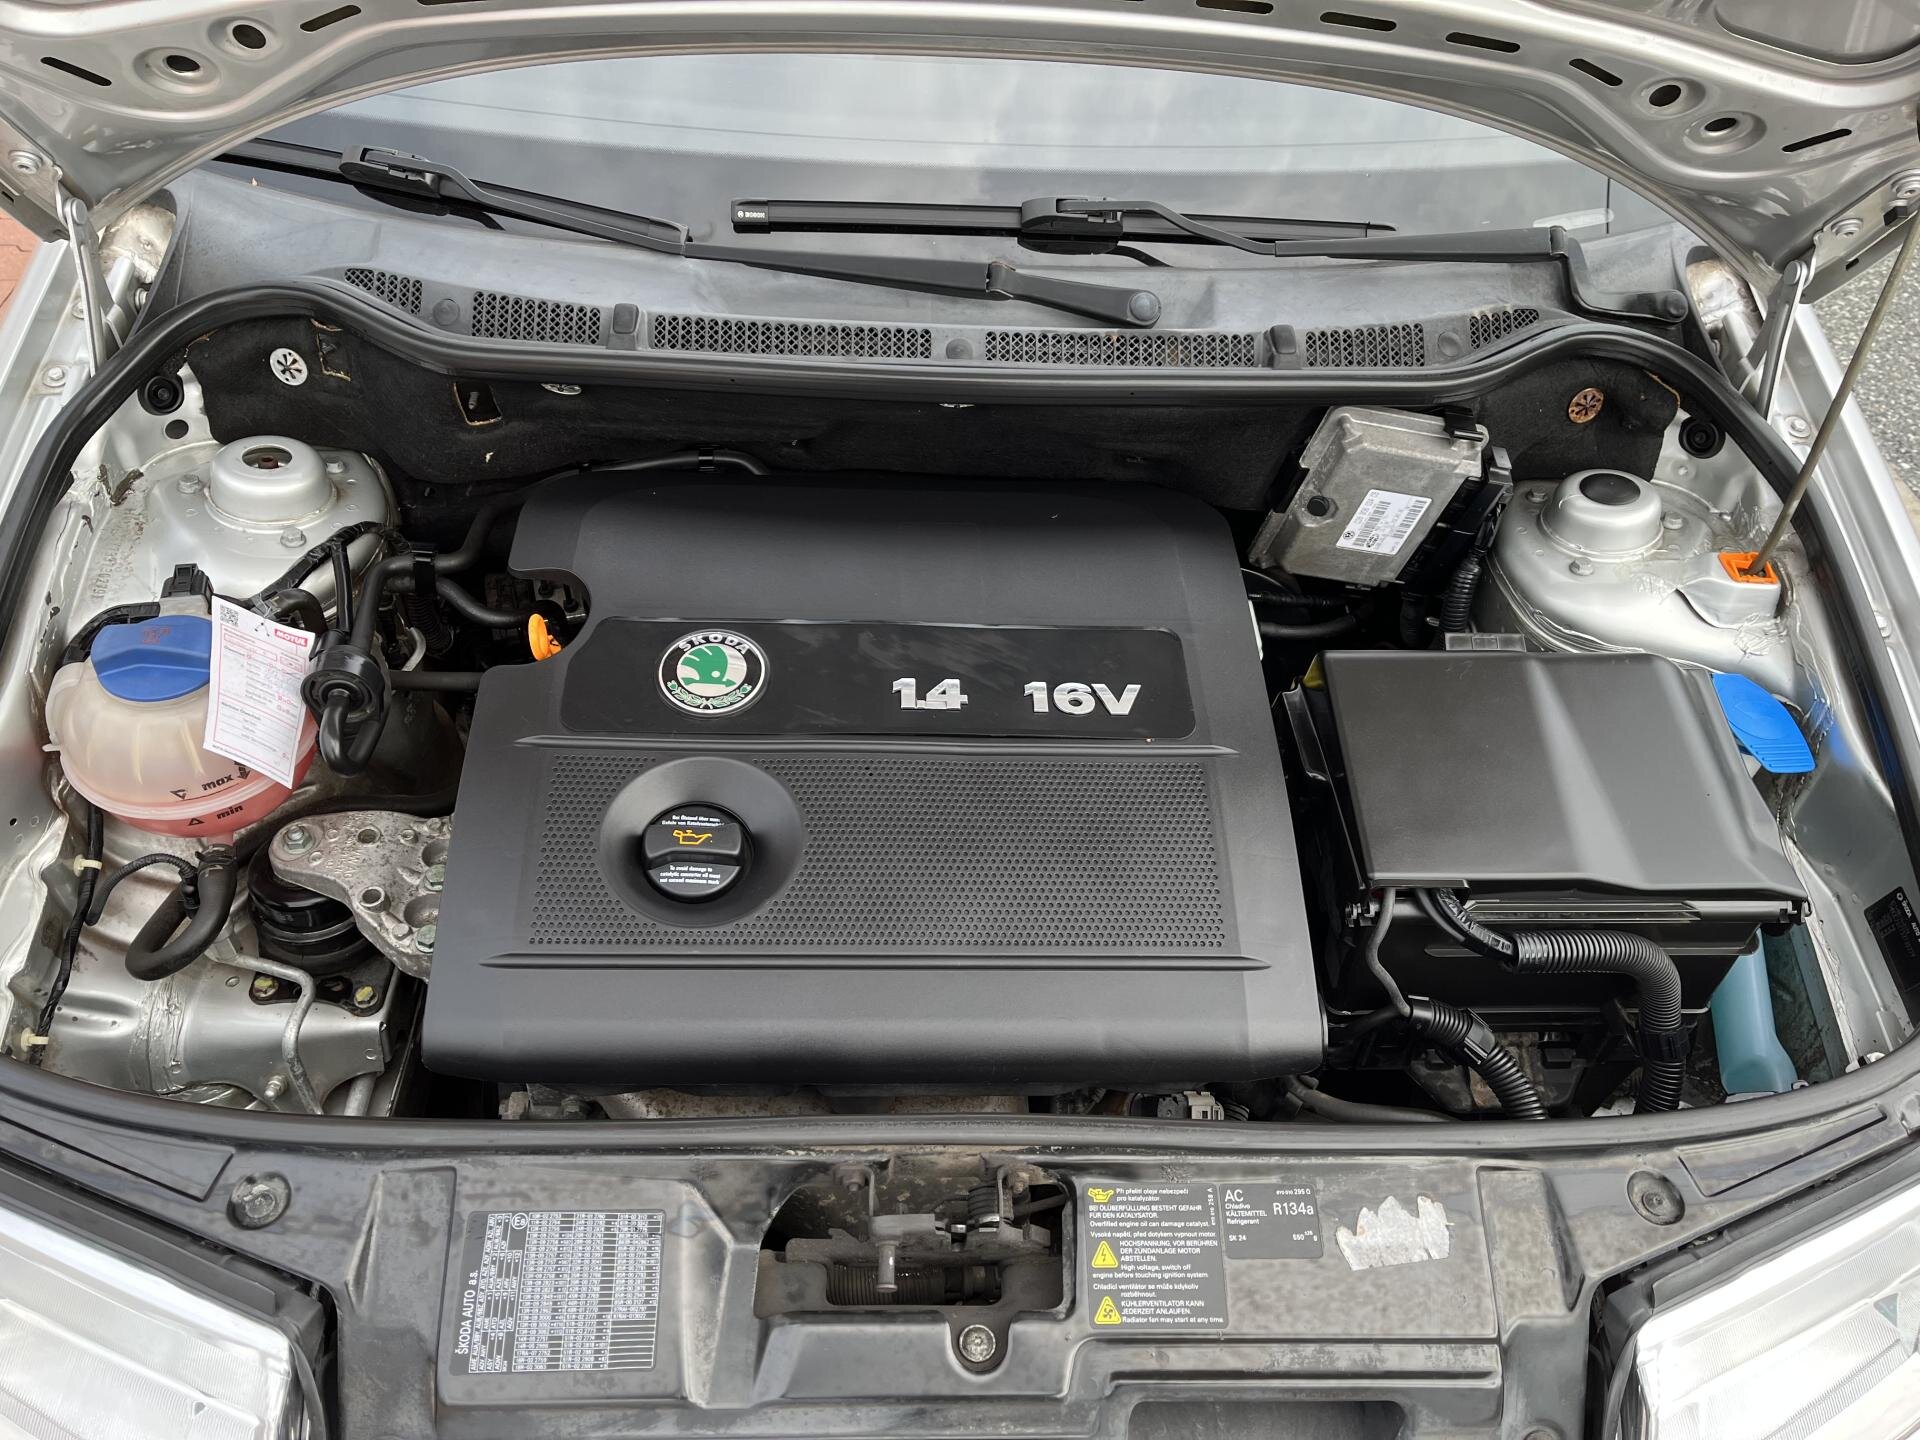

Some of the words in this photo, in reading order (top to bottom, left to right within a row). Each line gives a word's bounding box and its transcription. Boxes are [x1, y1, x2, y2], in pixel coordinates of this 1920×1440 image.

[276, 630, 308, 647] MOTUL
[892, 677, 969, 710] 1.4
[1024, 681, 1142, 716] 16V
[201, 774, 234, 791] max
[216, 805, 243, 819] min
[1224, 1189, 1244, 1202] AC
[1272, 1202, 1314, 1216] R134a
[1183, 1263, 1191, 1271] off
[1114, 1271, 1134, 1279] before
[461, 1289, 476, 1318] AUTO
[455, 1319, 473, 1355] ŠKODA
